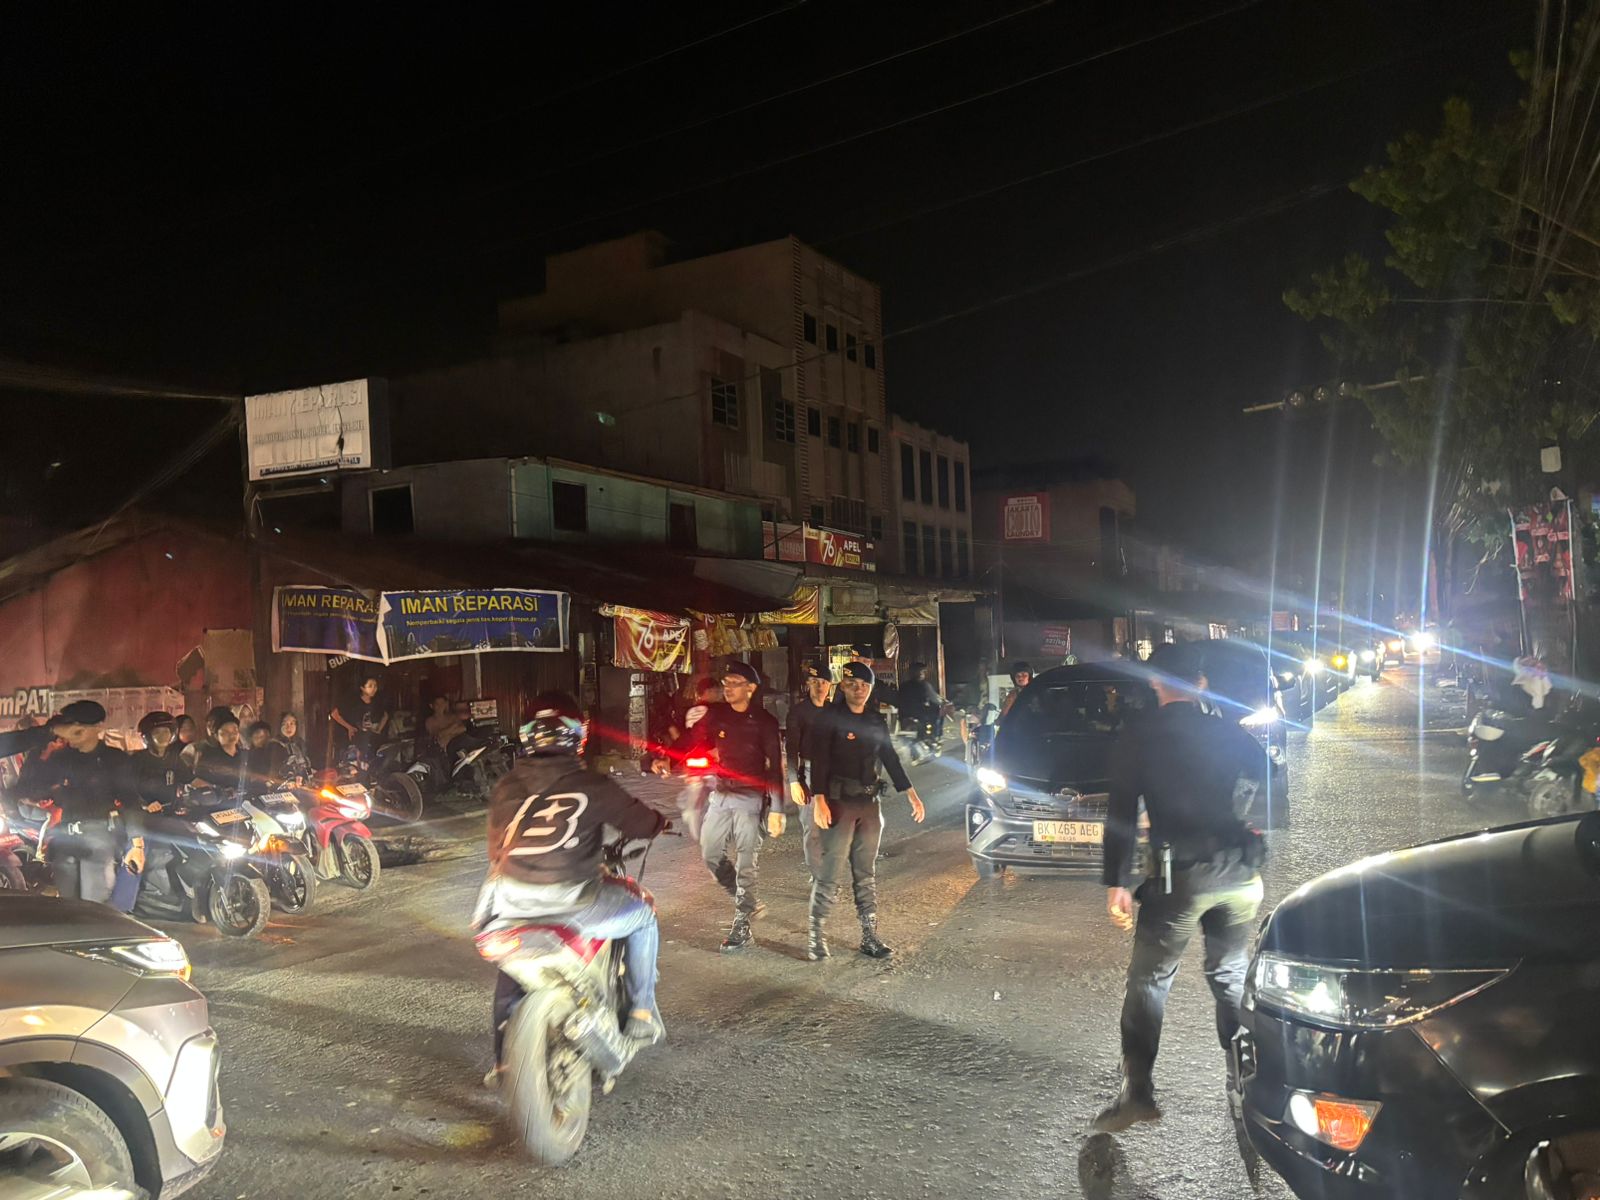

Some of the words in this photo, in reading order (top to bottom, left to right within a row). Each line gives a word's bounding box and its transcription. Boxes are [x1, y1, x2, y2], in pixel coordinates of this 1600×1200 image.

[823, 533, 835, 562] 76
[843, 539, 862, 553] APEL
[282, 593, 317, 608] IMAN
[400, 597, 449, 615] IMAN
[453, 594, 539, 613] REPARASI
[1037, 822, 1050, 835] BK
[1052, 823, 1077, 836] 1465
[1080, 824, 1099, 837] AEG
